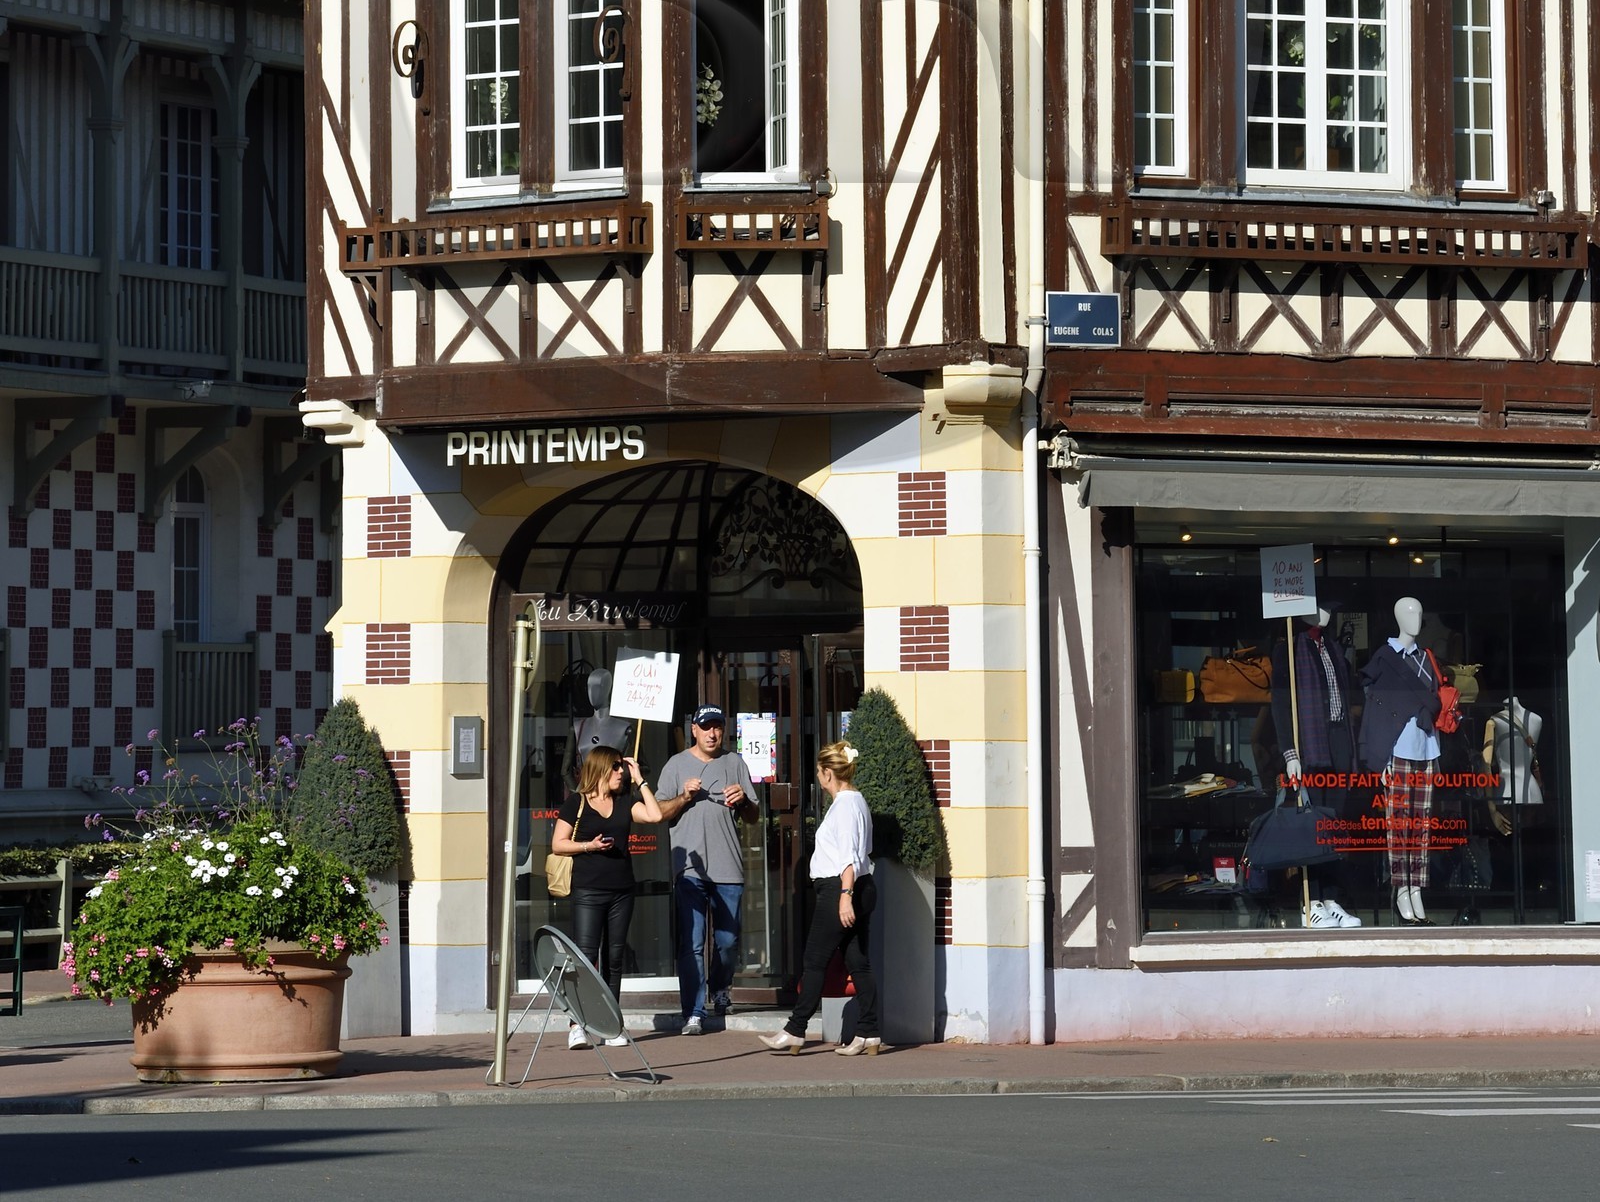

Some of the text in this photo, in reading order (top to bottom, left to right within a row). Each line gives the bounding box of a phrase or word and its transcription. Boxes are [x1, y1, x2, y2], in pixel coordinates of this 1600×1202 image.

[1077, 302, 1092, 312] RUE
[1053, 326, 1114, 336] EUGENE COLAS
[446, 425, 646, 467] PRINTEMPS
[1272, 560, 1303, 575] 10 ANS
[1274, 576, 1305, 587] DE MODE
[699, 707, 722, 715] SRIXON
[1280, 773, 1299, 787] LA
[1302, 773, 1347, 787] MODE
[1350, 773, 1382, 787] FAIT
[1385, 773, 1403, 787] SA
[1372, 794, 1410, 808] AVEC
[532, 810, 544, 819] LA
[1366, 836, 1386, 845] mode
[1431, 836, 1468, 846] Printemps
